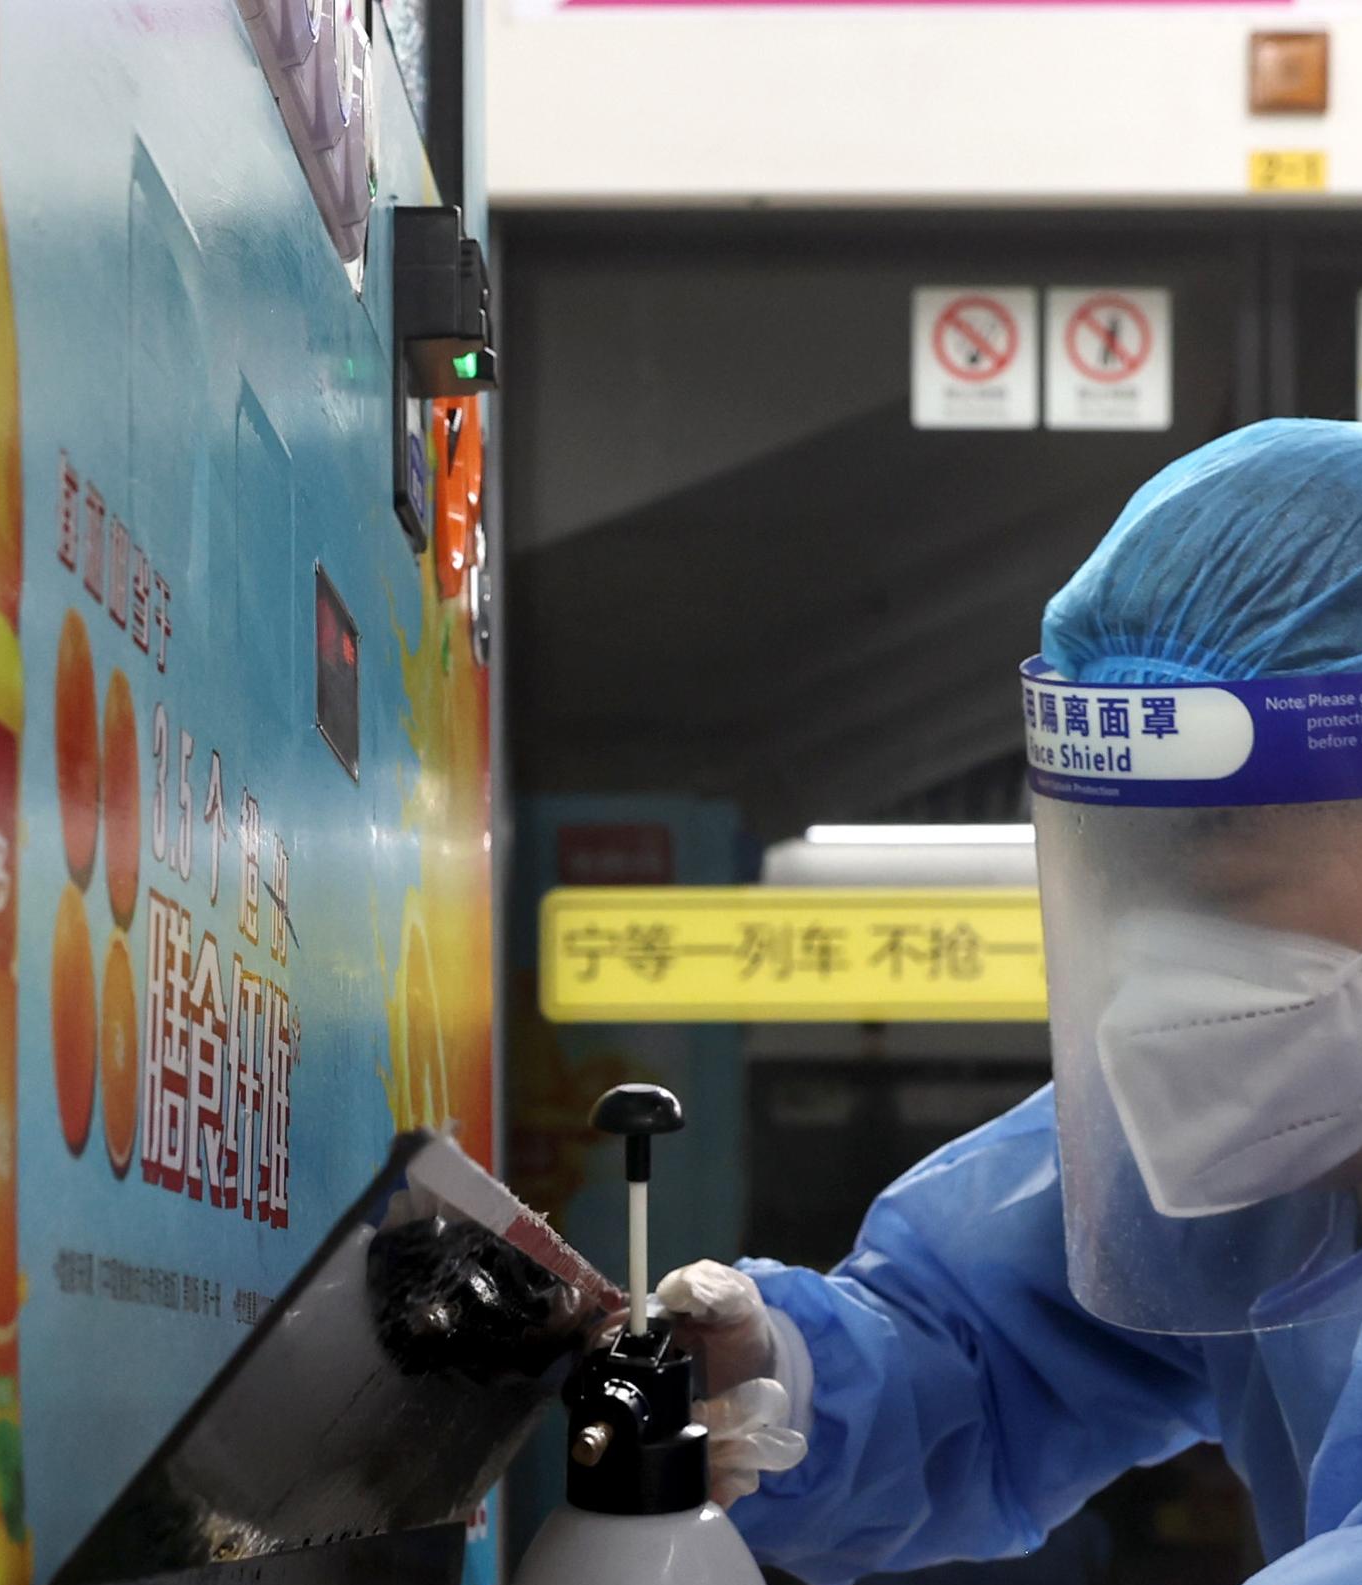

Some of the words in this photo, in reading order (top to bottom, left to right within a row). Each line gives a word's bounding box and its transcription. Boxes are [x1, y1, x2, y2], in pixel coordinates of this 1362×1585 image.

[1308, 692, 1356, 708] Please
[1308, 735, 1357, 750] before
[1061, 743, 1132, 773] Shield
[562, 921, 850, 983] 宁等一列车
[866, 921, 1048, 983] 不抢一
[142, 887, 289, 1229] 膳食纤维
